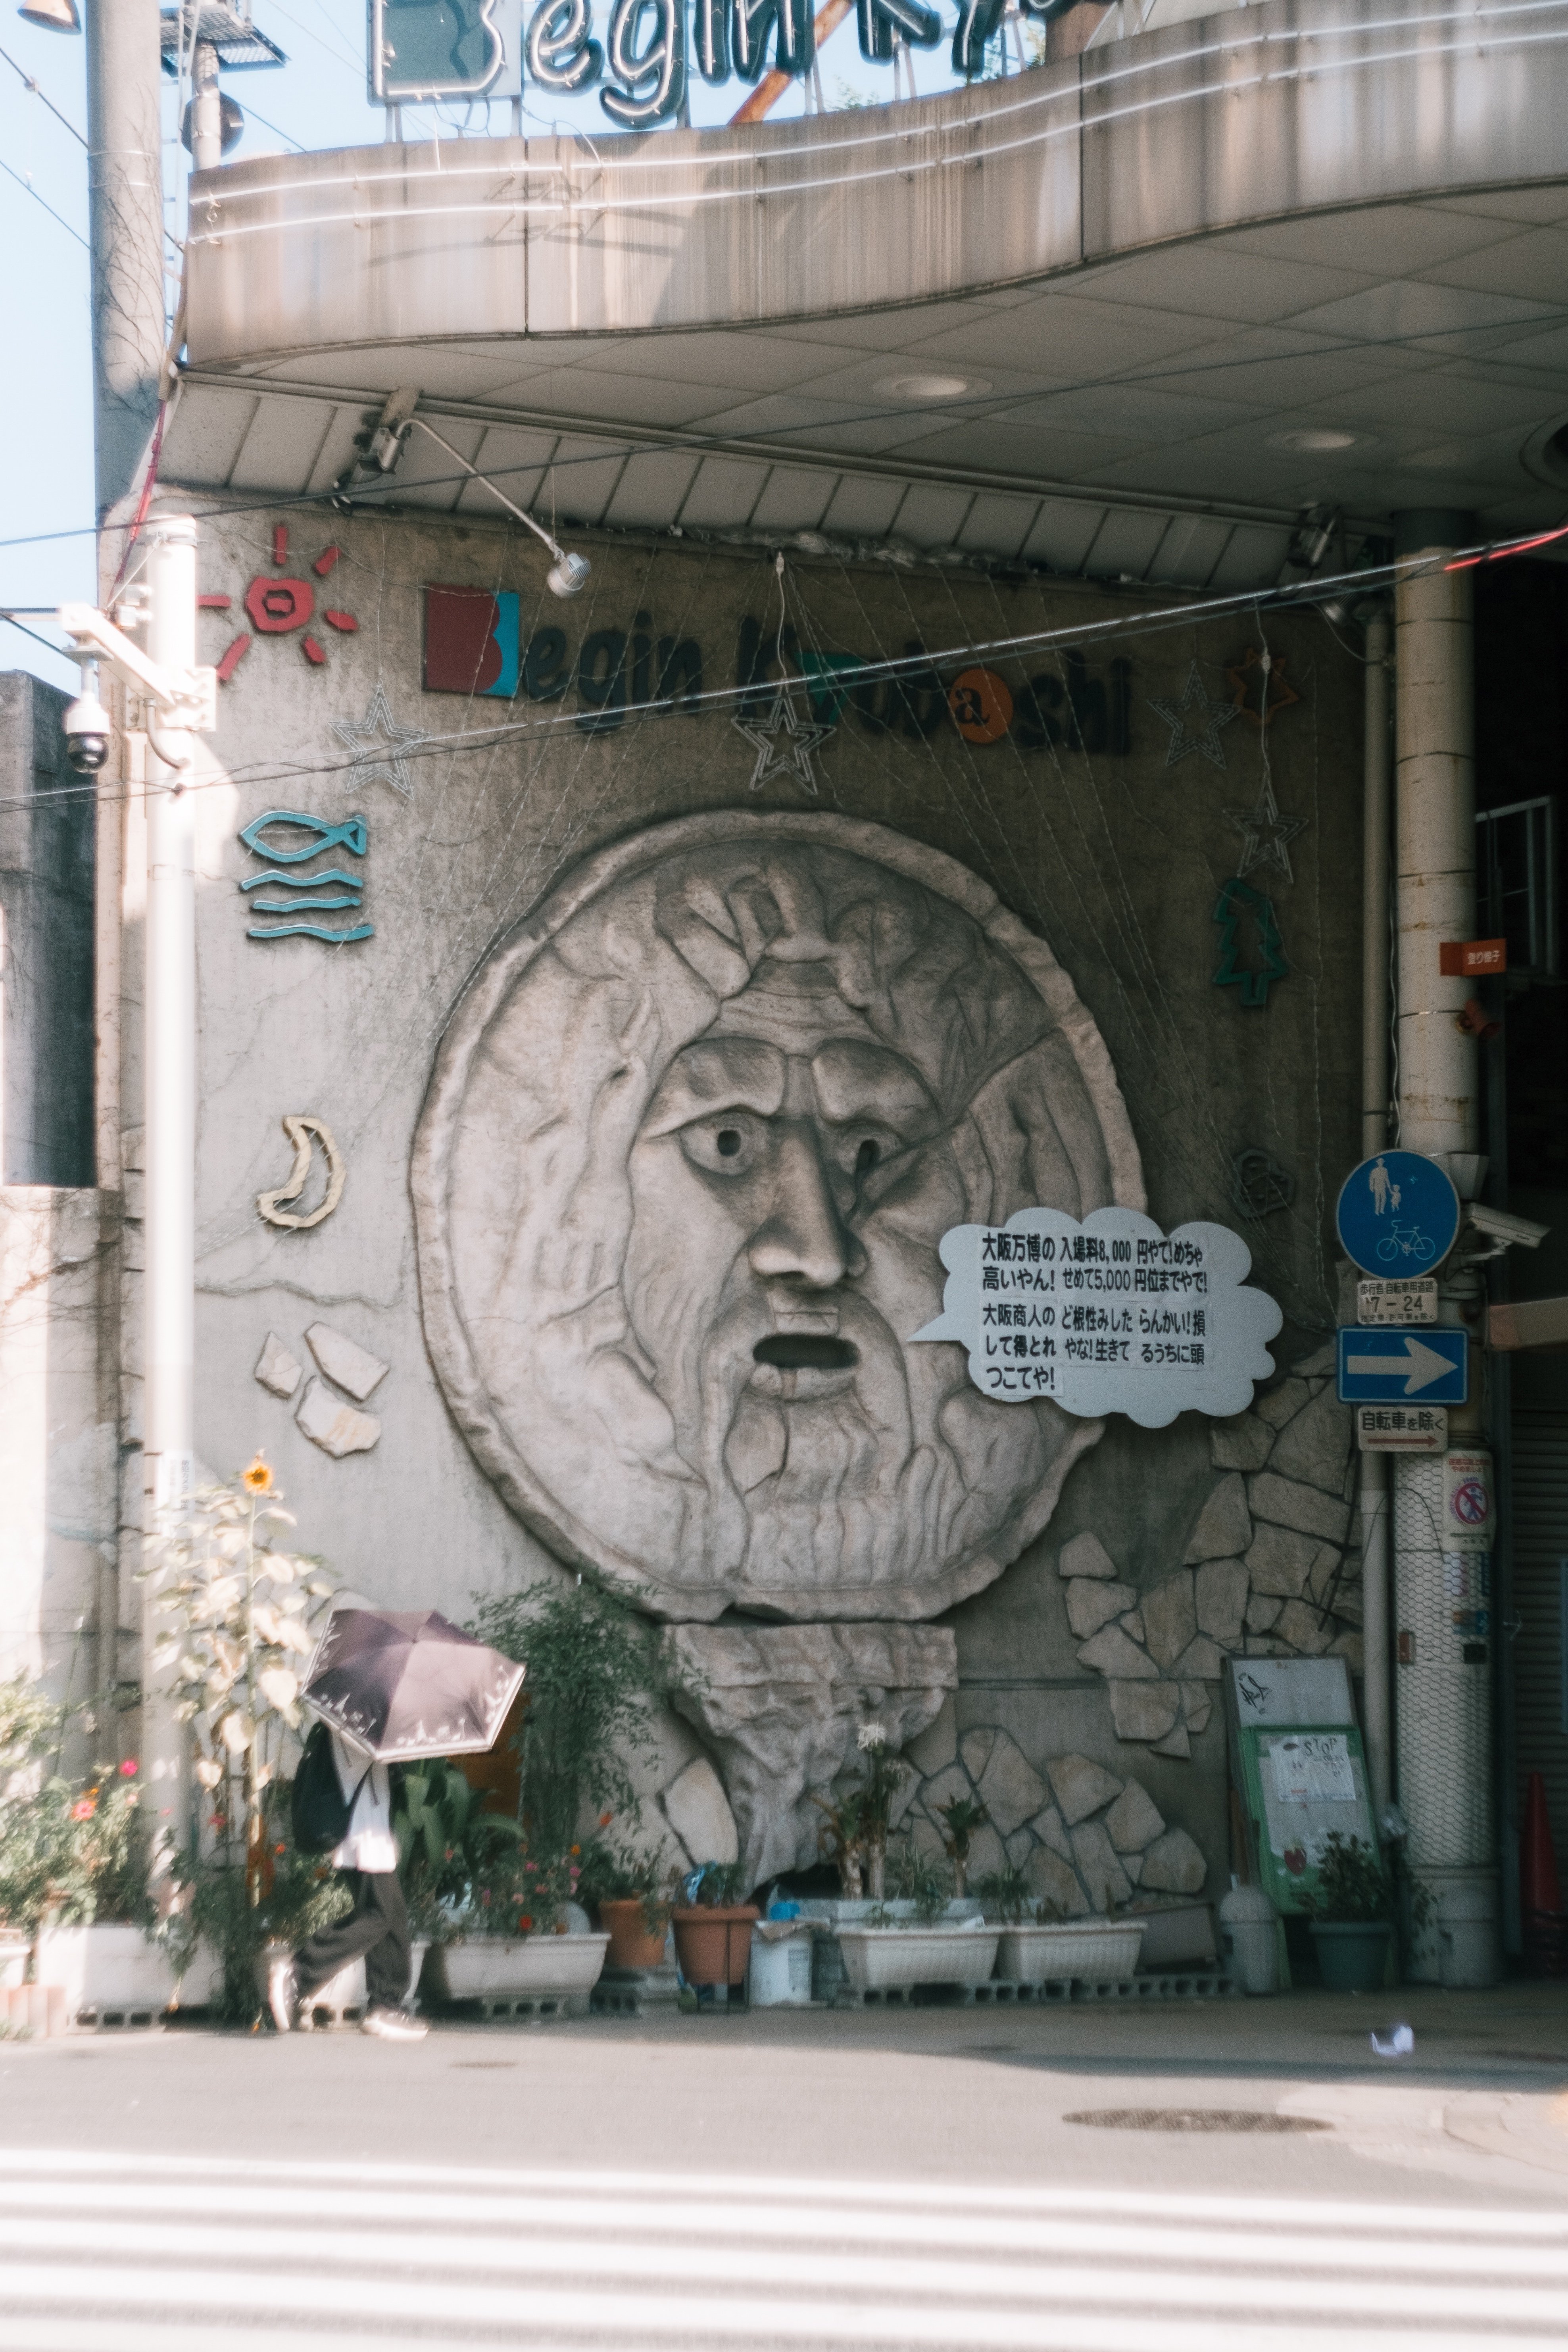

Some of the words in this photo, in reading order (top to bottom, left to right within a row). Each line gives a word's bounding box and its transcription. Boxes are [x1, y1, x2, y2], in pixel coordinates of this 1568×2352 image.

[1362, 1410, 1444, 1432] 自転車を除く
